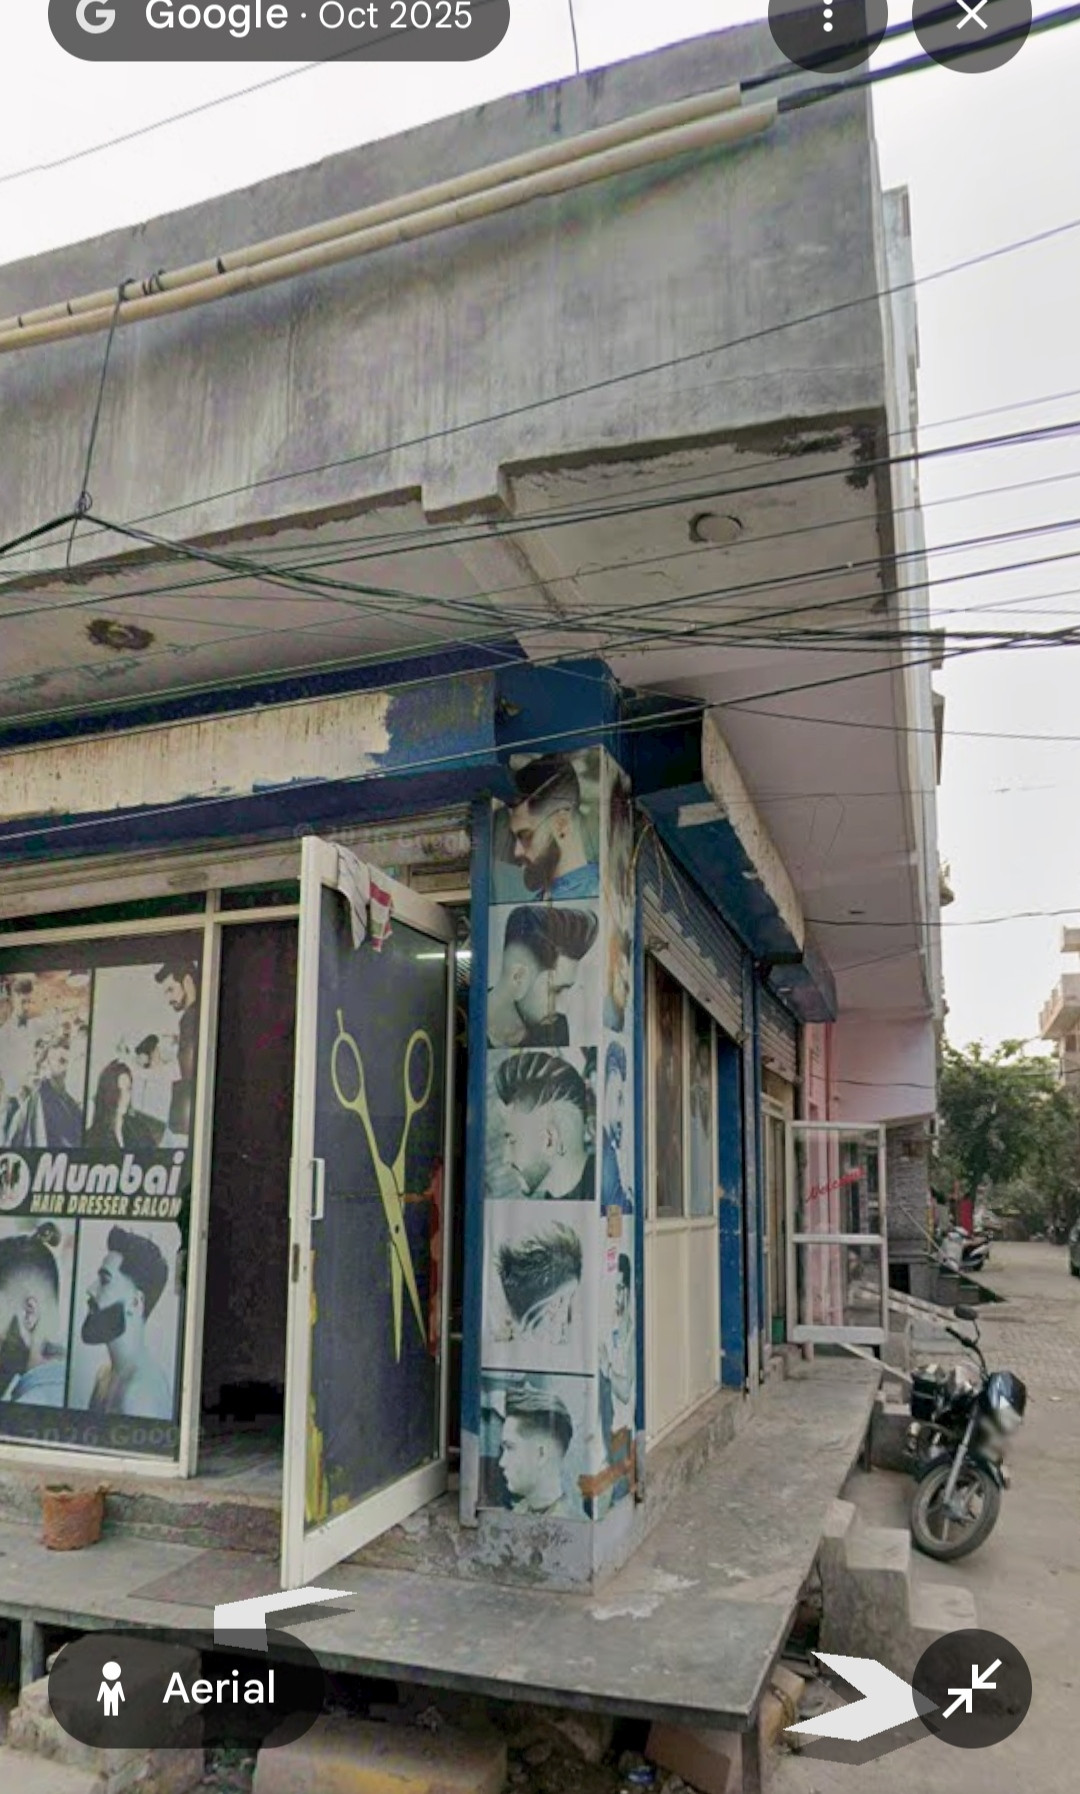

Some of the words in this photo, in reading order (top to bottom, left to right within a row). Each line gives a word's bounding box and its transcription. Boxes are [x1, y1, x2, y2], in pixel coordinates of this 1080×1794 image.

[31, 1151, 185, 1195] Mumbai
[30, 1193, 66, 1213] HAIR
[67, 1195, 130, 1216] DRESSER
[132, 1197, 182, 1218] SALON
